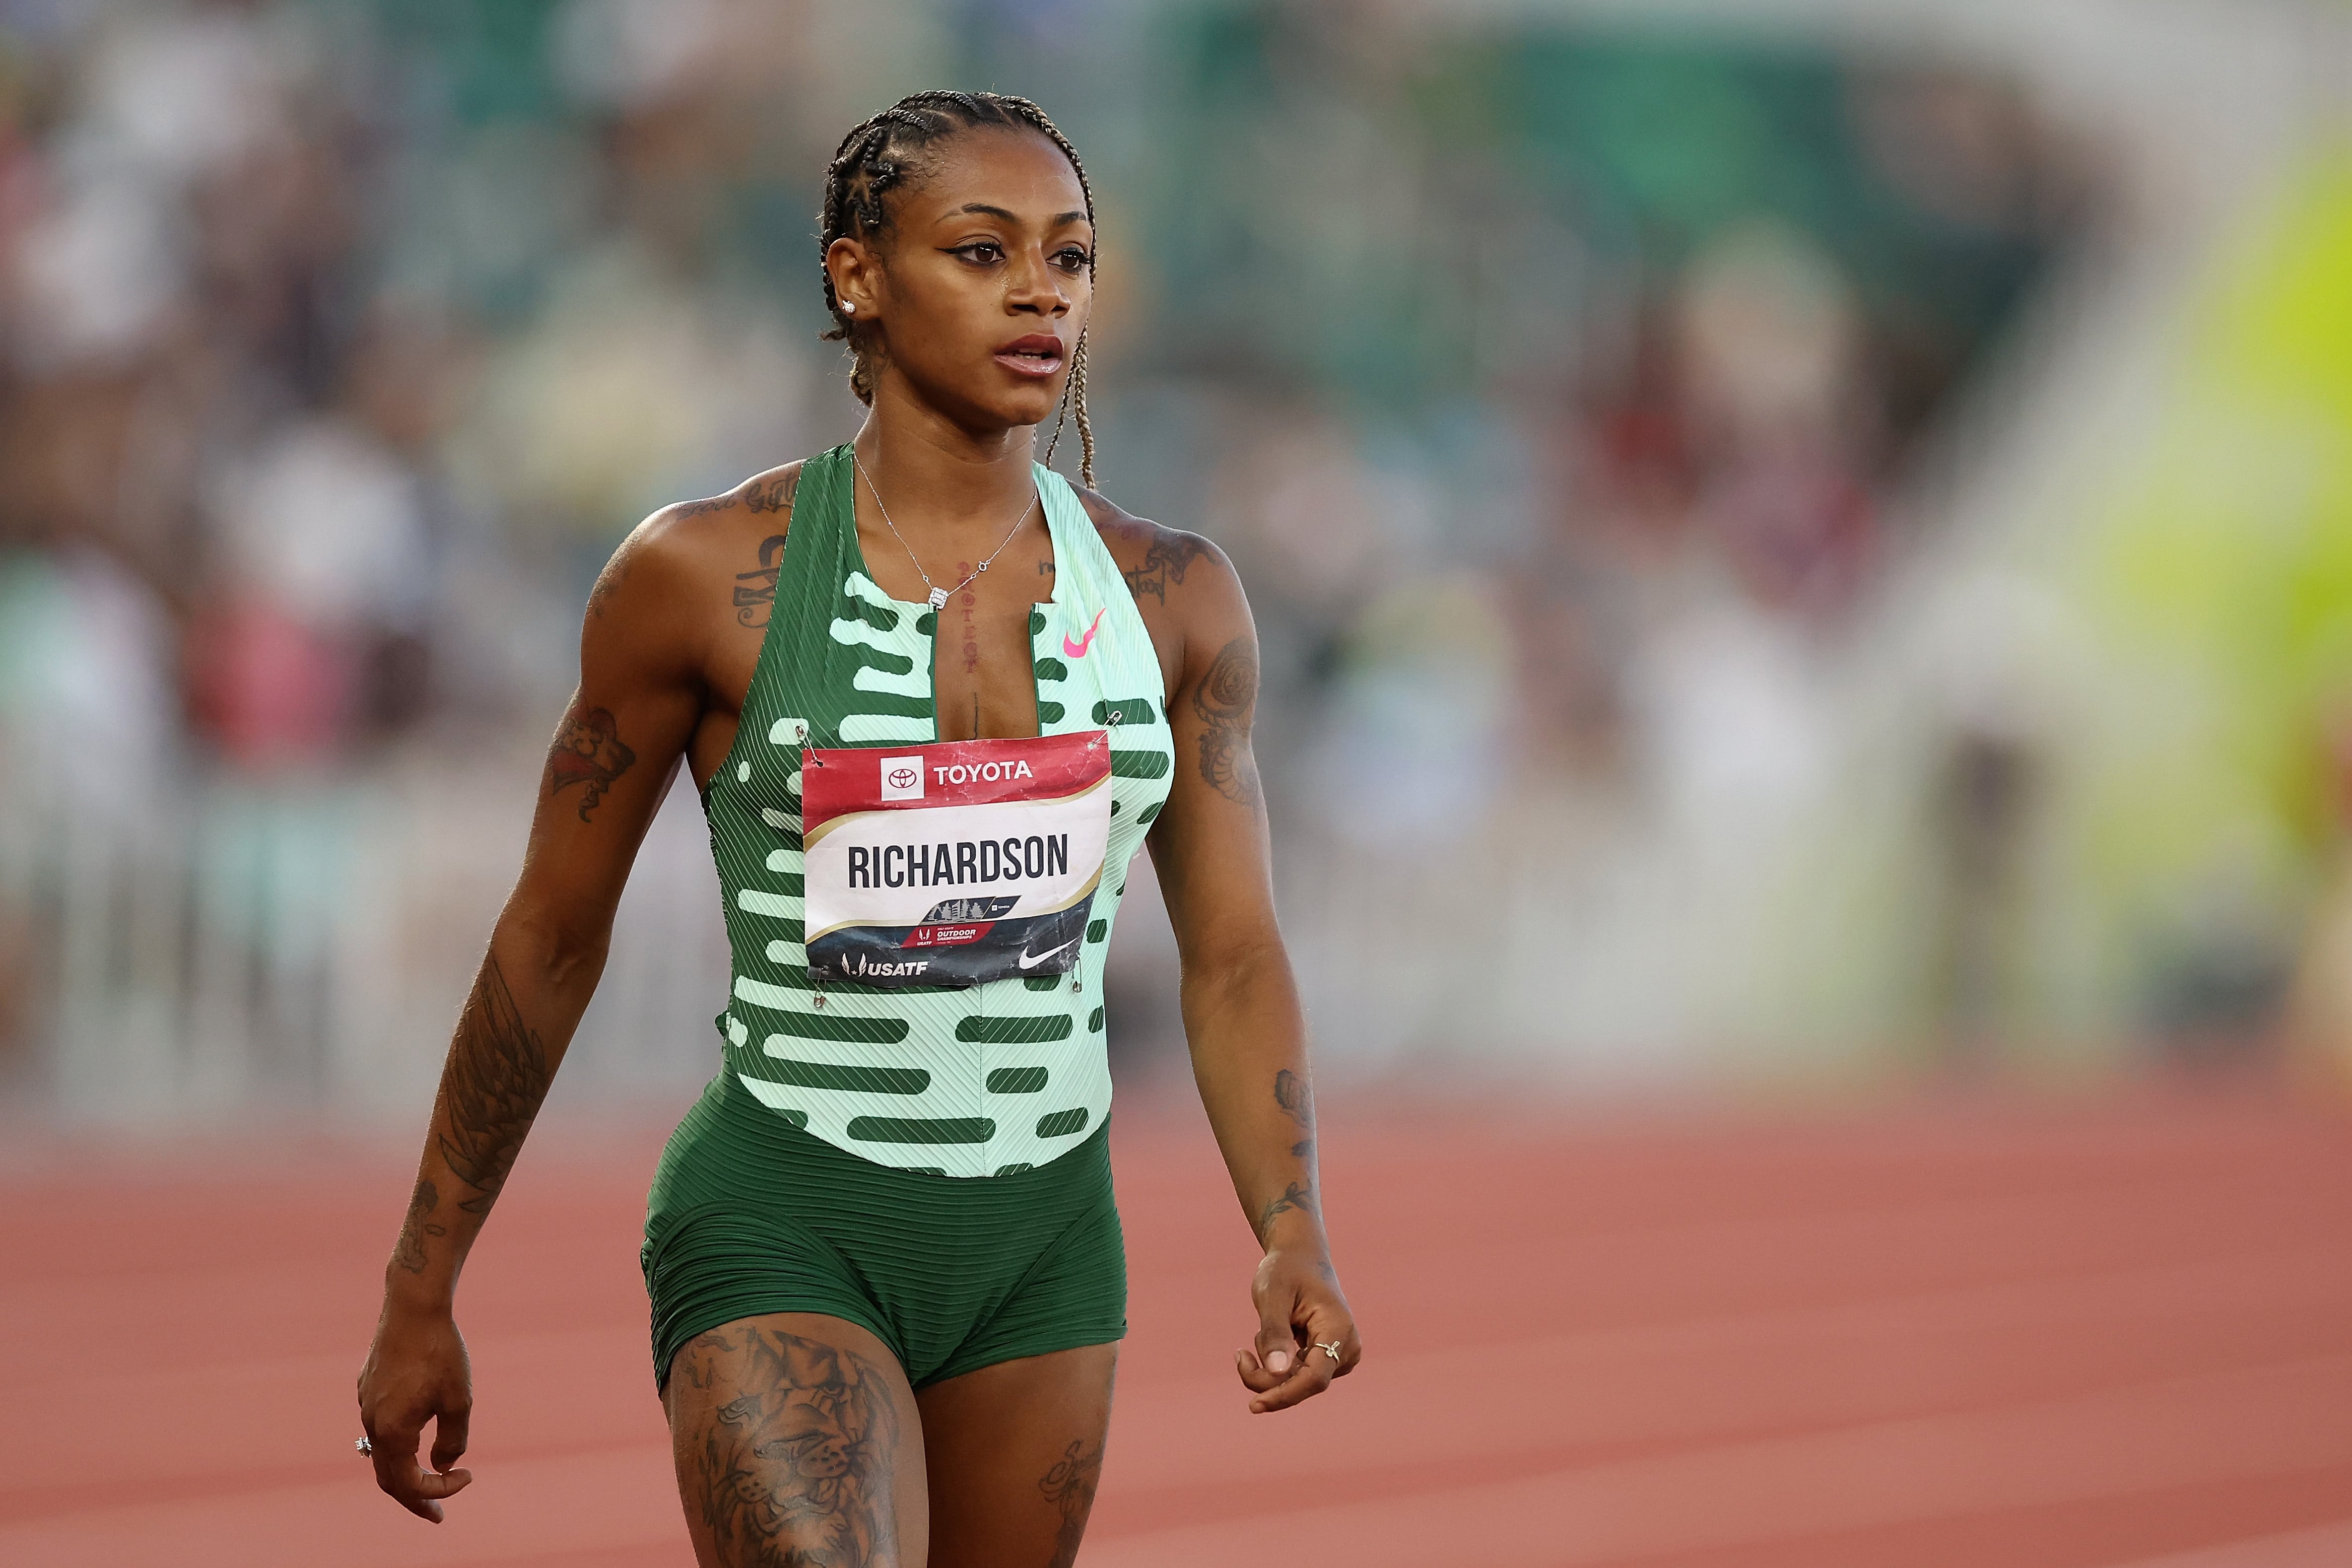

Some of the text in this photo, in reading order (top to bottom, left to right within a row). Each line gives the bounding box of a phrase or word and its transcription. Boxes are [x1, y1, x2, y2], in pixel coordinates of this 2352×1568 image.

[933, 760, 1033, 785] TOYOTA
[848, 834, 1068, 888] RICHARDSON
[937, 929, 976, 937] OUTDOOR
[867, 961, 928, 977] USATF
